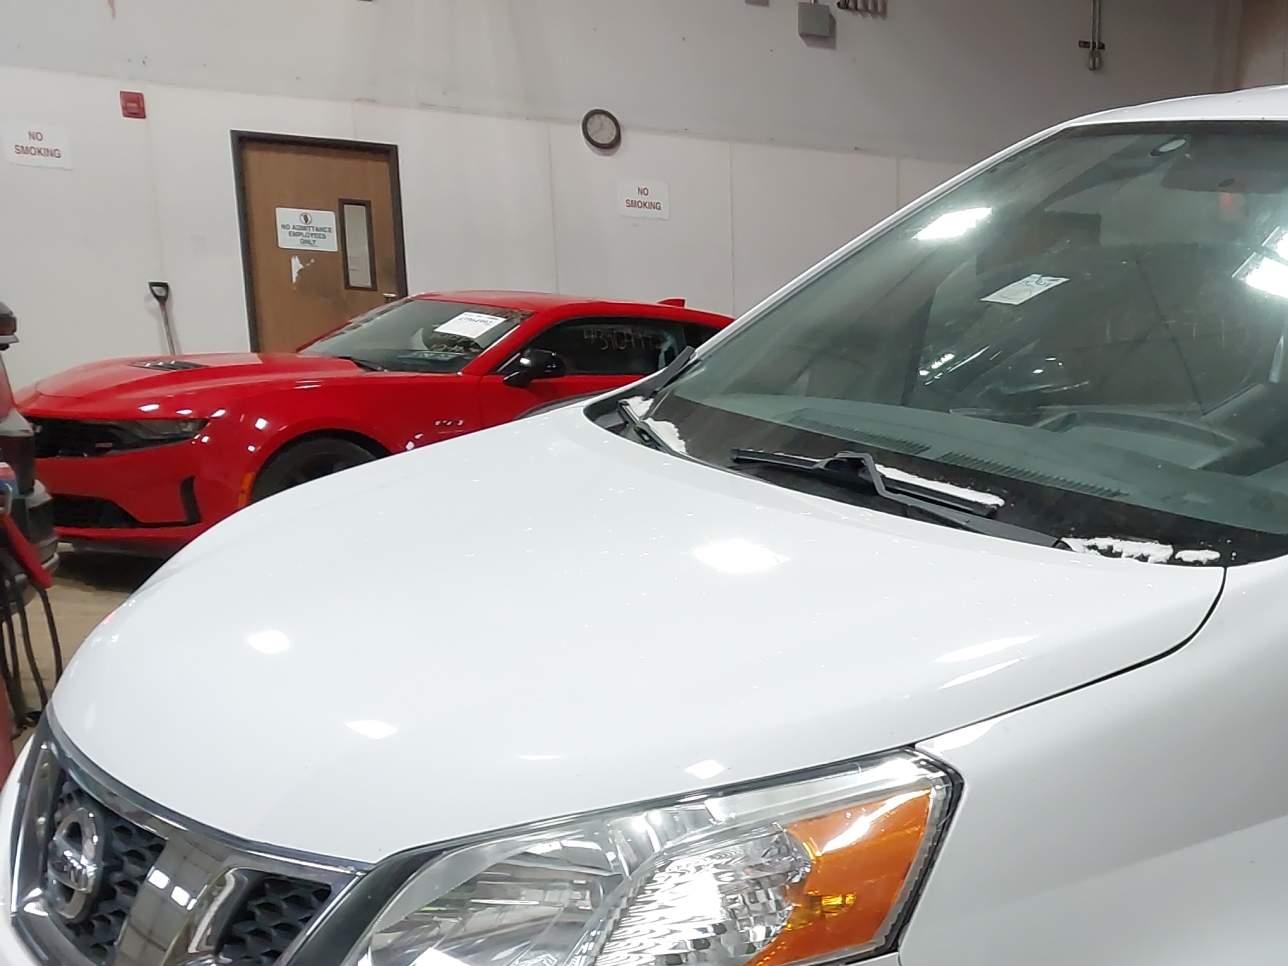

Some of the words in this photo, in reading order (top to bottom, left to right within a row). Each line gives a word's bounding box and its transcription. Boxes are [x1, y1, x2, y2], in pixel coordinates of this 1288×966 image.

[28, 131, 43, 142] NO
[14, 144, 62, 159] SMOKING
[637, 187, 649, 196] NO
[625, 199, 662, 211] SMOKING
